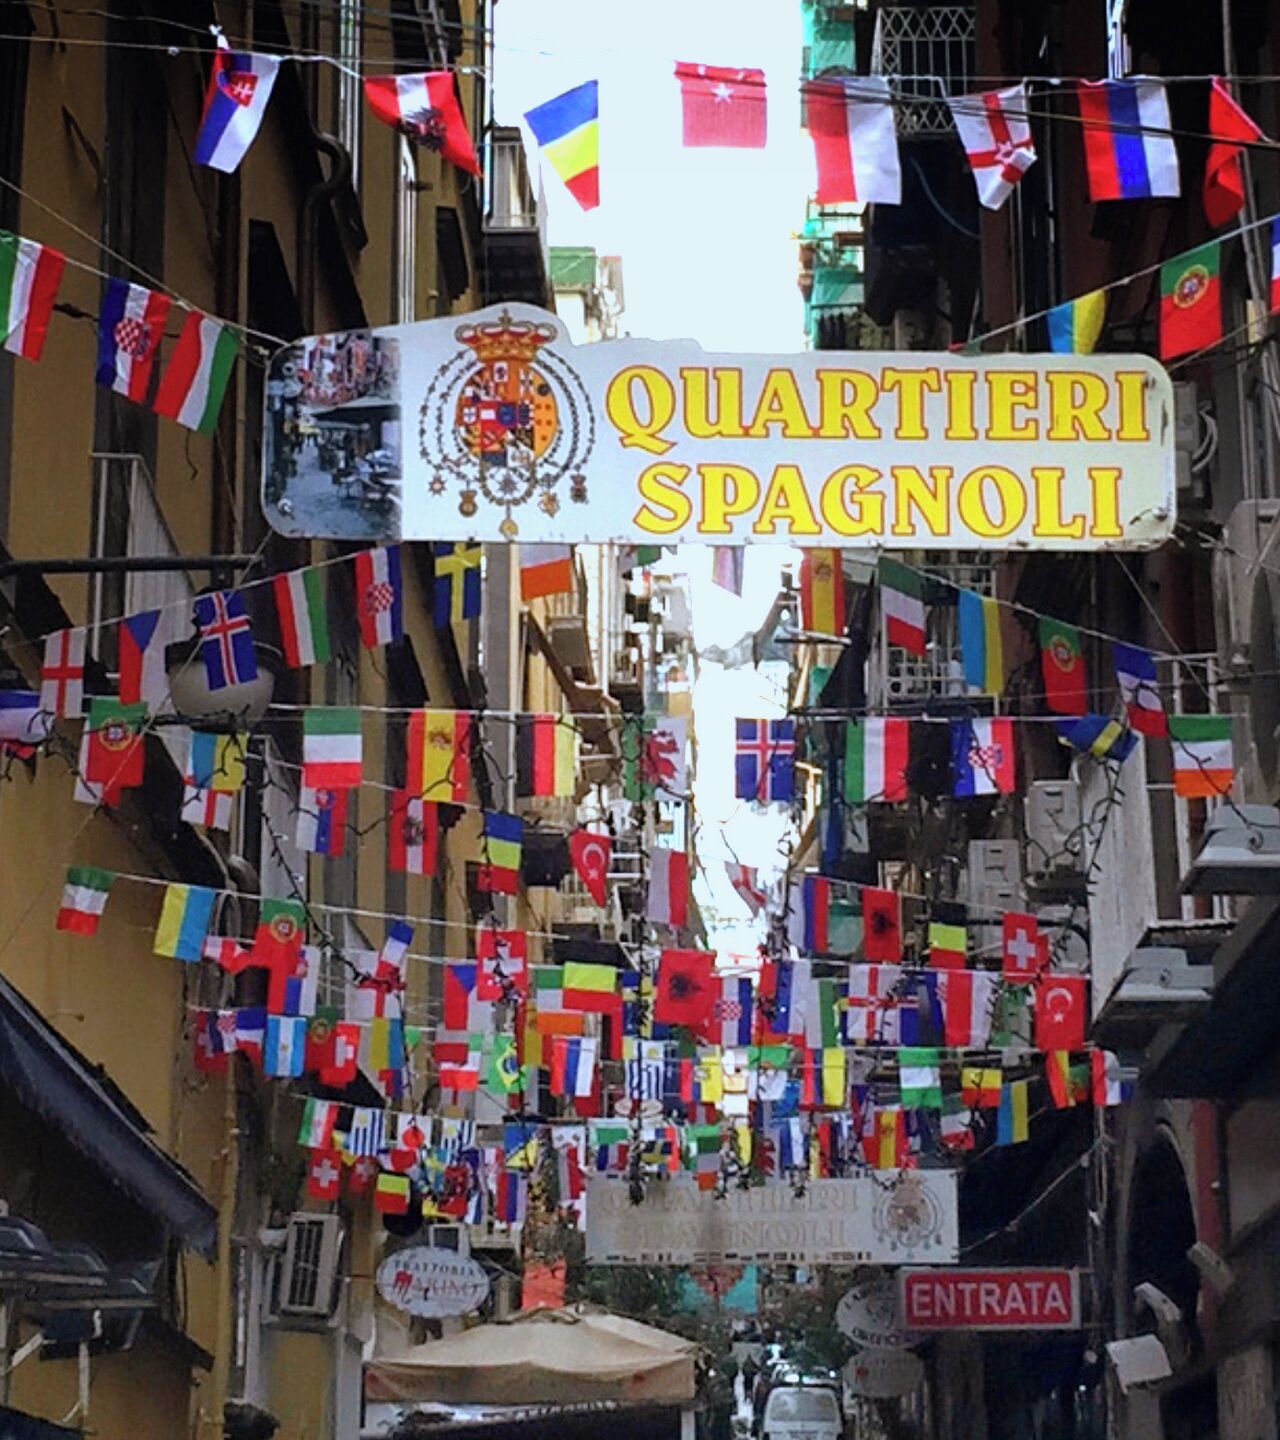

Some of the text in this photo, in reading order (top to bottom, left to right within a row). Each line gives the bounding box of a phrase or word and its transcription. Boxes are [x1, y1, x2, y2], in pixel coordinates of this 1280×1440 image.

[605, 366, 1150, 455] QUARTIERI
[634, 465, 1122, 539] SPAGNOLI
[912, 1282, 1069, 1320] ENTRATA
